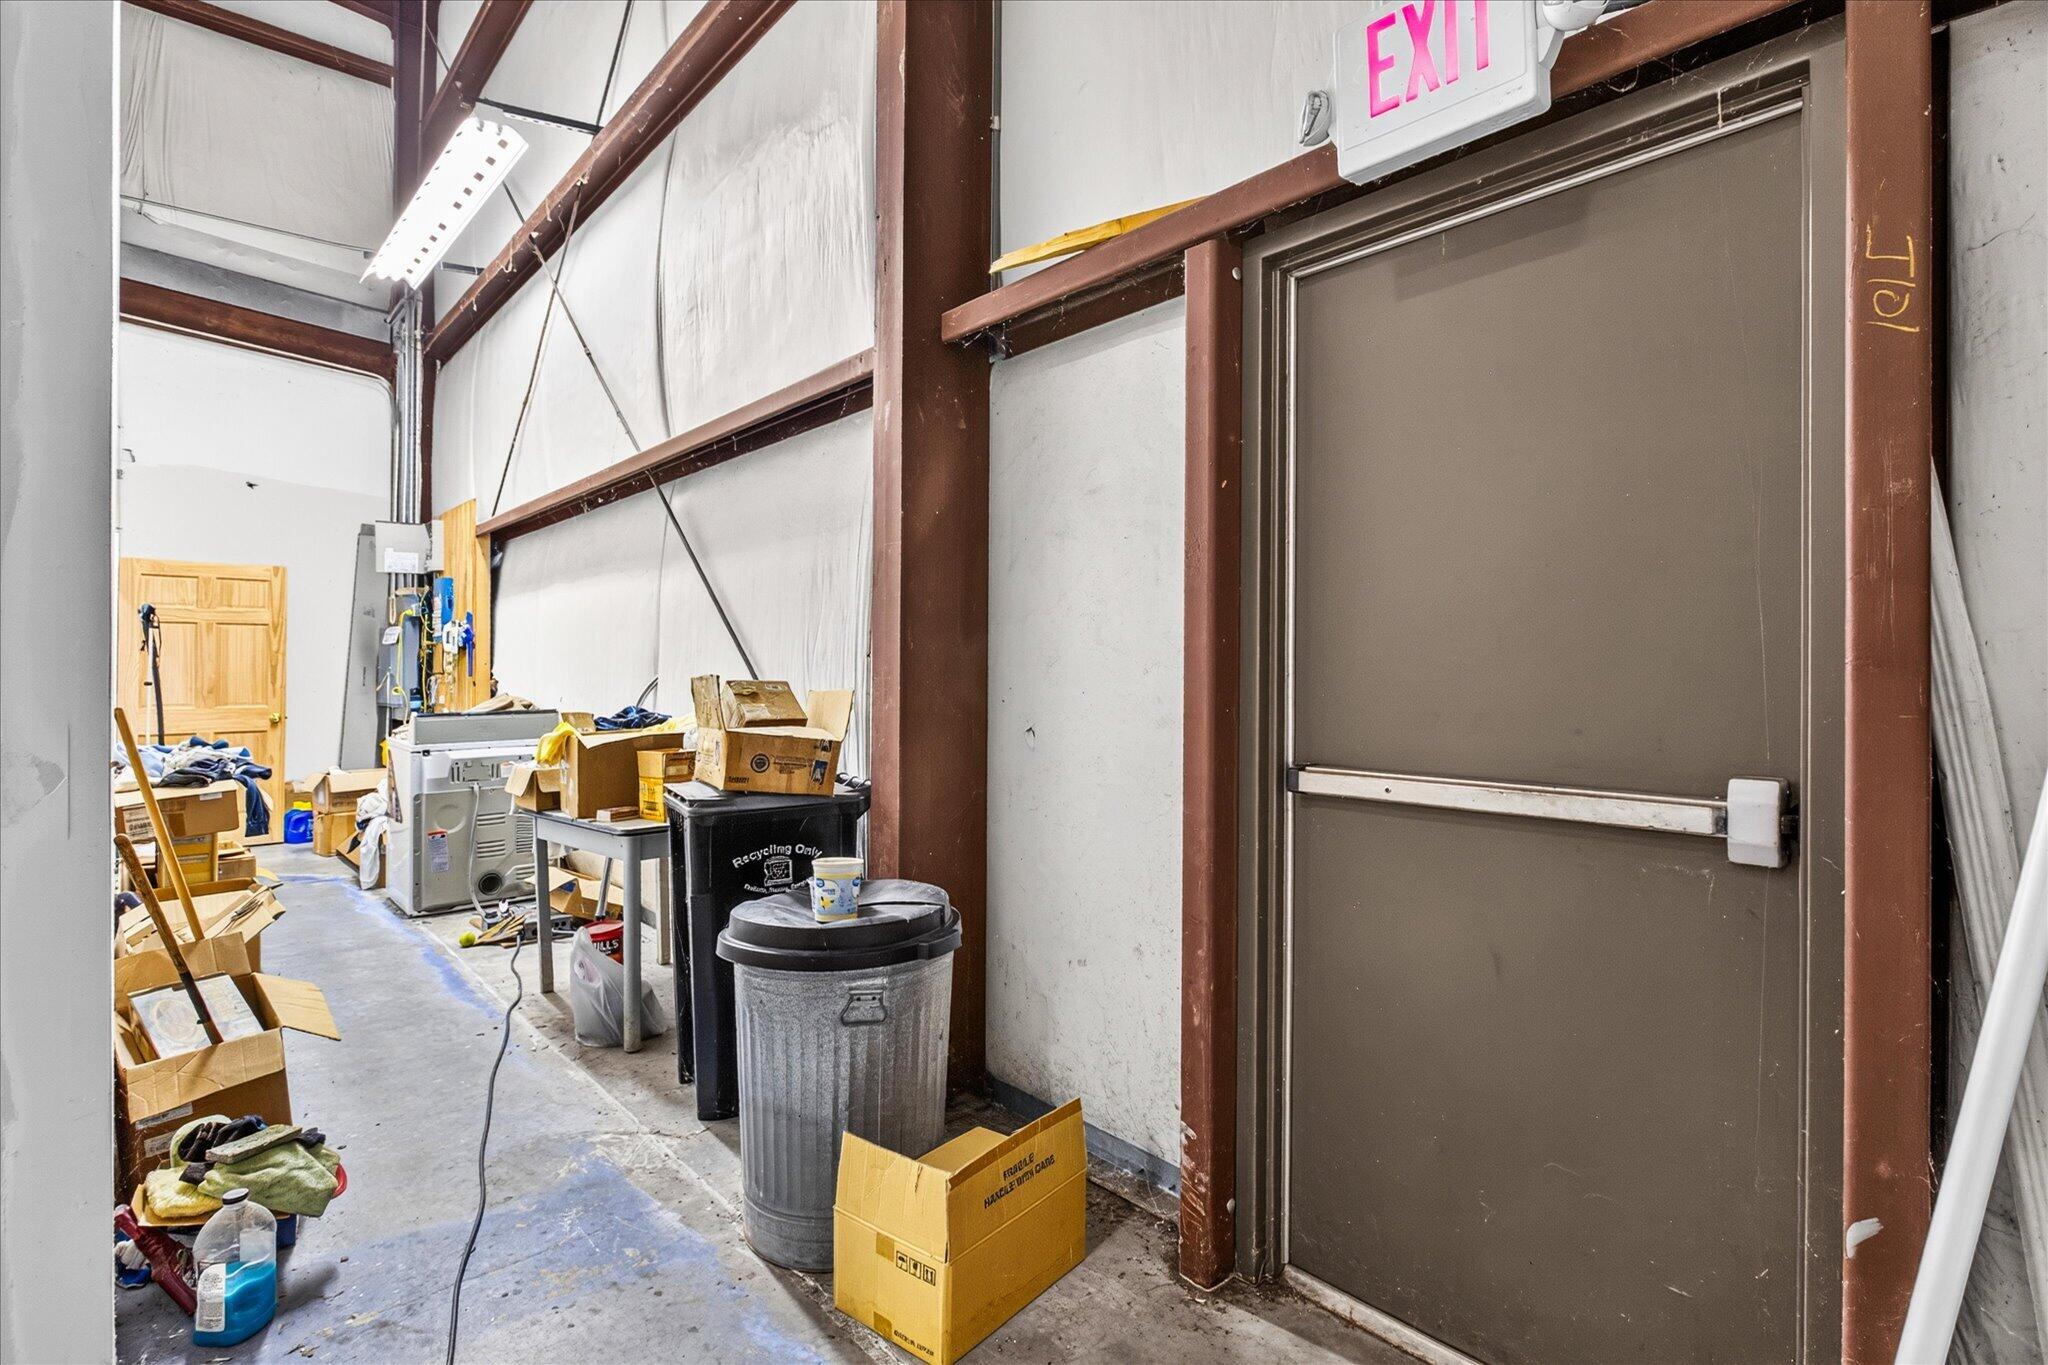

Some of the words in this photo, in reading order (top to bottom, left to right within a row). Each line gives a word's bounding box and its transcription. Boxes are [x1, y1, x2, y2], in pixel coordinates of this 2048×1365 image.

[1366, 0, 1490, 119] EXIT
[732, 844, 792, 868] Recycling
[795, 844, 823, 858] Only
[593, 939, 619, 951] ILLS
[984, 1180, 1015, 1210] HANDLE
[1016, 1168, 1035, 1187] WITH
[1034, 1154, 1055, 1173] CARE
